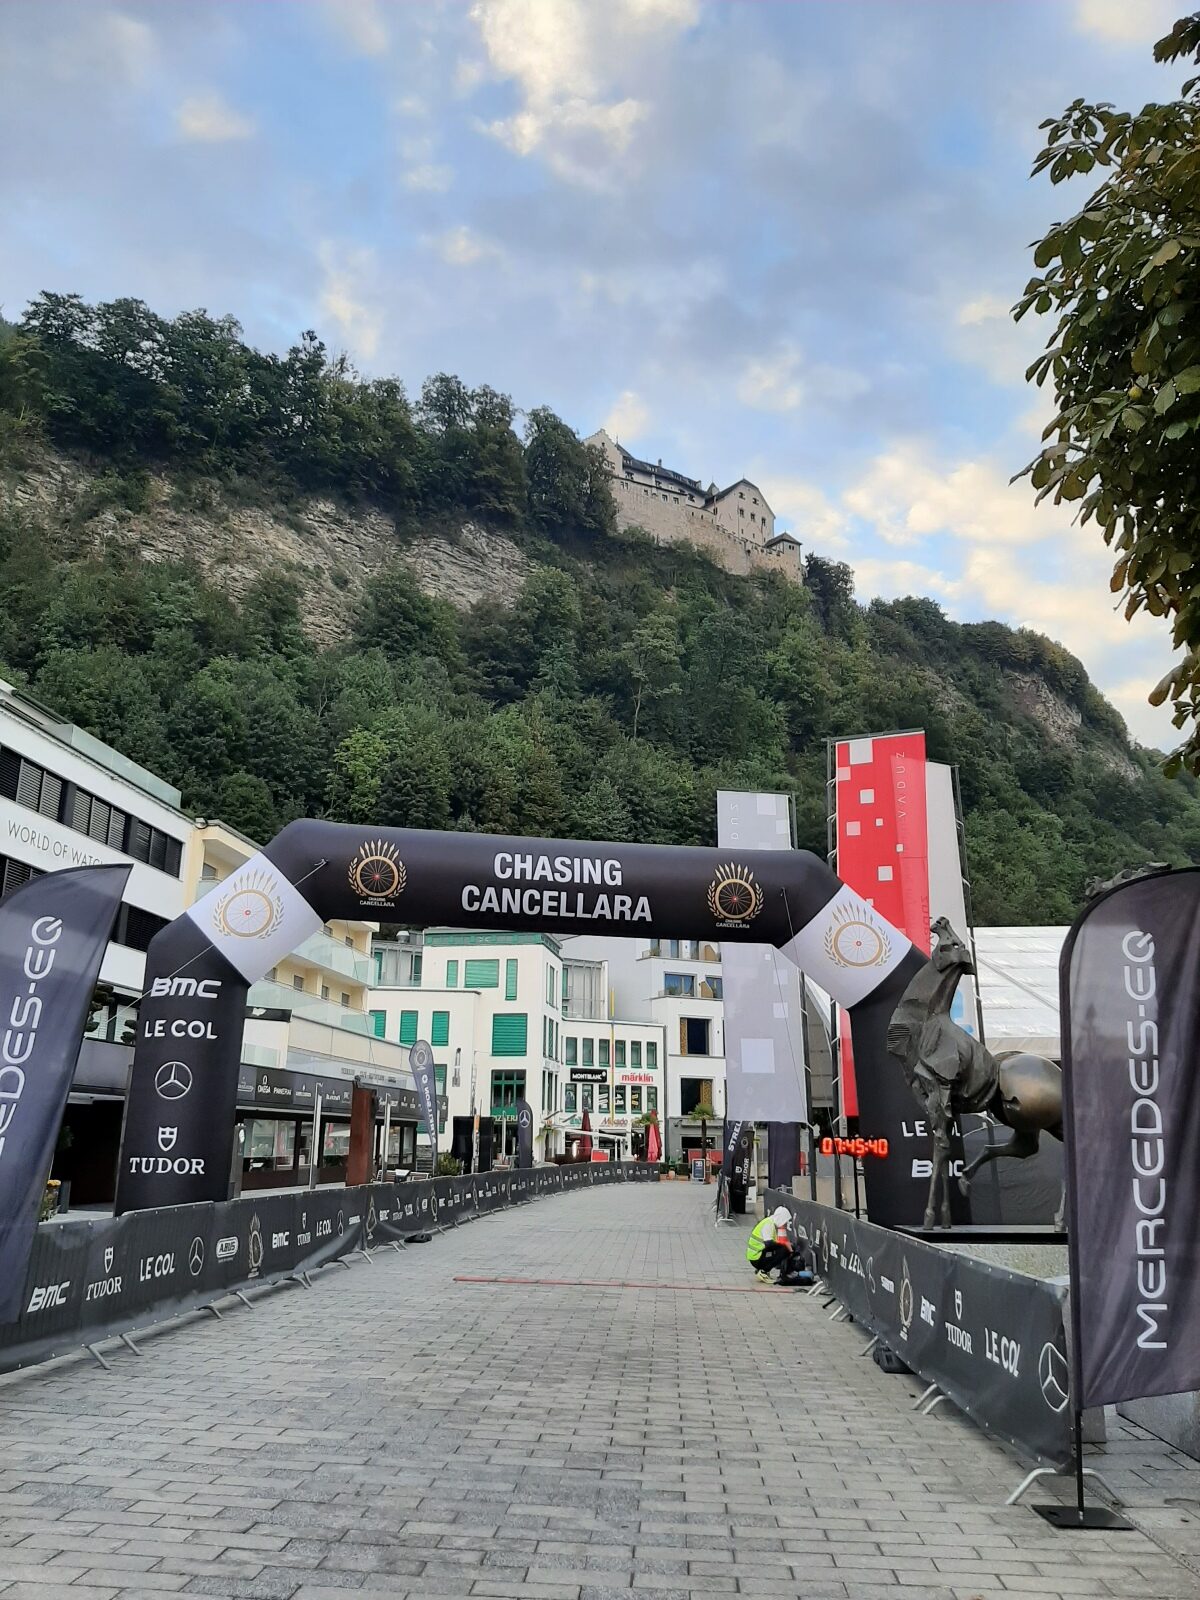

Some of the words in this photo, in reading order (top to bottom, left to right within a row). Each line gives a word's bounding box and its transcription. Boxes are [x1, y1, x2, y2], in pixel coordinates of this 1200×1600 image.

[897, 752, 906, 818] VADUZ
[7, 819, 50, 851] WORLD
[53, 841, 69, 858] OF
[71, 847, 103, 866] WATC
[494, 851, 623, 887] CHASING
[461, 884, 653, 923] CANCELLARA
[150, 977, 222, 999] BMC
[144, 1020, 165, 1038] LE
[170, 1020, 218, 1040] COL
[621, 1073, 654, 1083] märklin
[902, 1121, 928, 1137] LE
[1122, 930, 1168, 1350] MERCEDES-EQ
[822, 1137, 888, 1156] 07:45:40
[129, 1157, 205, 1175] TUDOR
[742, 1158, 750, 1185] TUDOR
[912, 1158, 964, 1178] BC
[272, 1231, 290, 1249] BMC
[139, 1256, 155, 1282] LE
[155, 1252, 175, 1279] COL
[27, 1280, 70, 1314] BMC
[86, 1275, 122, 1301] TUDOR
[920, 1296, 936, 1327] BMC
[945, 1321, 973, 1354] TUDOR
[985, 1327, 1000, 1364] LE
[1000, 1336, 1020, 1377] COL
